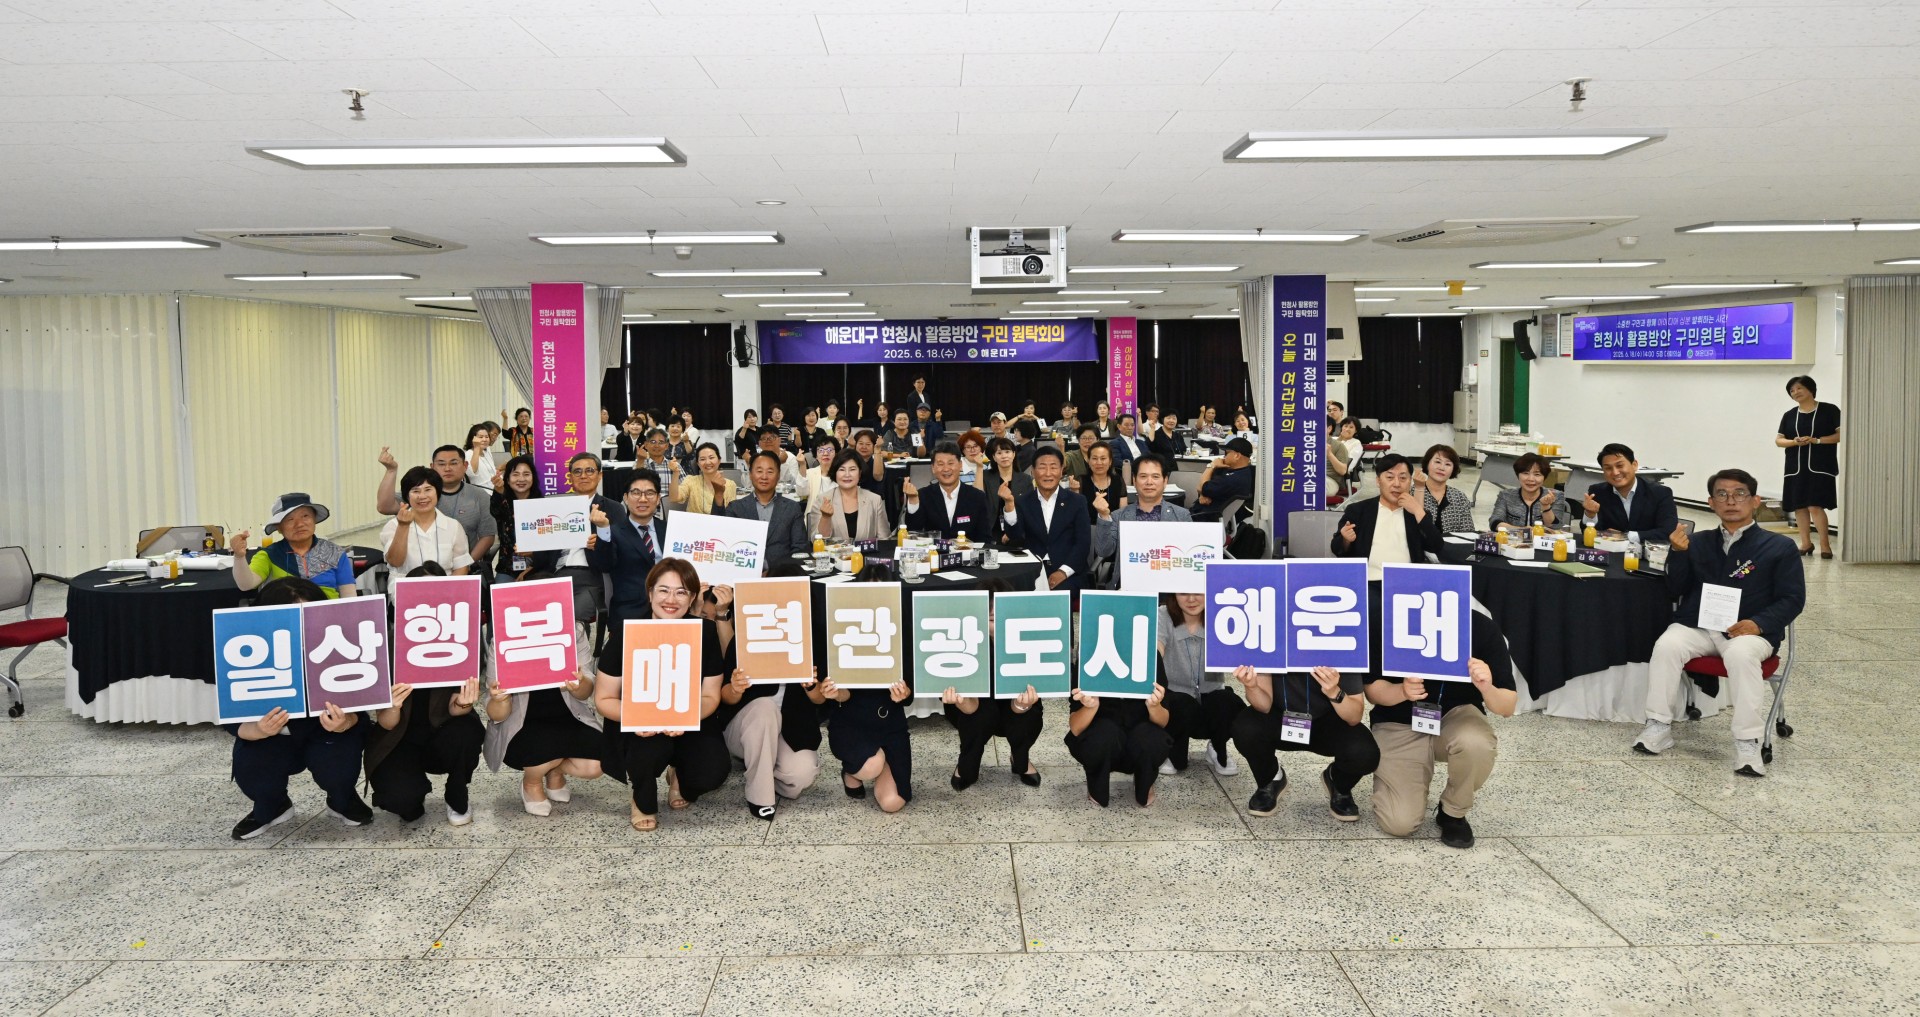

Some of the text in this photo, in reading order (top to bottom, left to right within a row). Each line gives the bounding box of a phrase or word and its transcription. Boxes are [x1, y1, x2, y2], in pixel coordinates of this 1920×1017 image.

[825, 325, 879, 345] 해운대구
[882, 325, 922, 344] 현청사
[925, 325, 979, 344] 활용방안
[982, 325, 1009, 343] 구민
[1011, 324, 1066, 343] 원탁회의
[1281, 309, 1294, 318] 구민
[1594, 331, 1624, 349] 현청사
[1627, 329, 1672, 348] 활용방안
[1675, 326, 1727, 347] 구민원탁
[1731, 324, 1760, 346] 회의
[884, 349, 914, 359] 2025.
[981, 348, 1018, 358] 해운대구
[542, 341, 558, 496] 현청사 활용방안 고민
[564, 421, 579, 451] 폭싹
[1281, 333, 1297, 492] 오늘 여러분의 목소리
[1303, 333, 1317, 511] 미래 정책에 반영하겠습니
[521, 517, 553, 531] 일상행복
[672, 540, 716, 554] 일상행복
[1128, 548, 1172, 563] 일상행복
[692, 550, 757, 569] 매력관광도시
[1150, 556, 1205, 572] 매력관광도
[403, 601, 470, 668] 행
[499, 601, 572, 672] 복
[741, 600, 803, 665] 력
[832, 606, 897, 669] 관
[919, 615, 984, 678] 광
[999, 616, 1066, 677] 도
[1083, 613, 1149, 683] 시
[1214, 586, 1276, 653] 해
[1291, 585, 1361, 651] 운
[1392, 590, 1459, 662] 대
[223, 628, 297, 702] 일
[308, 619, 384, 693] 상
[631, 643, 691, 714] 매
